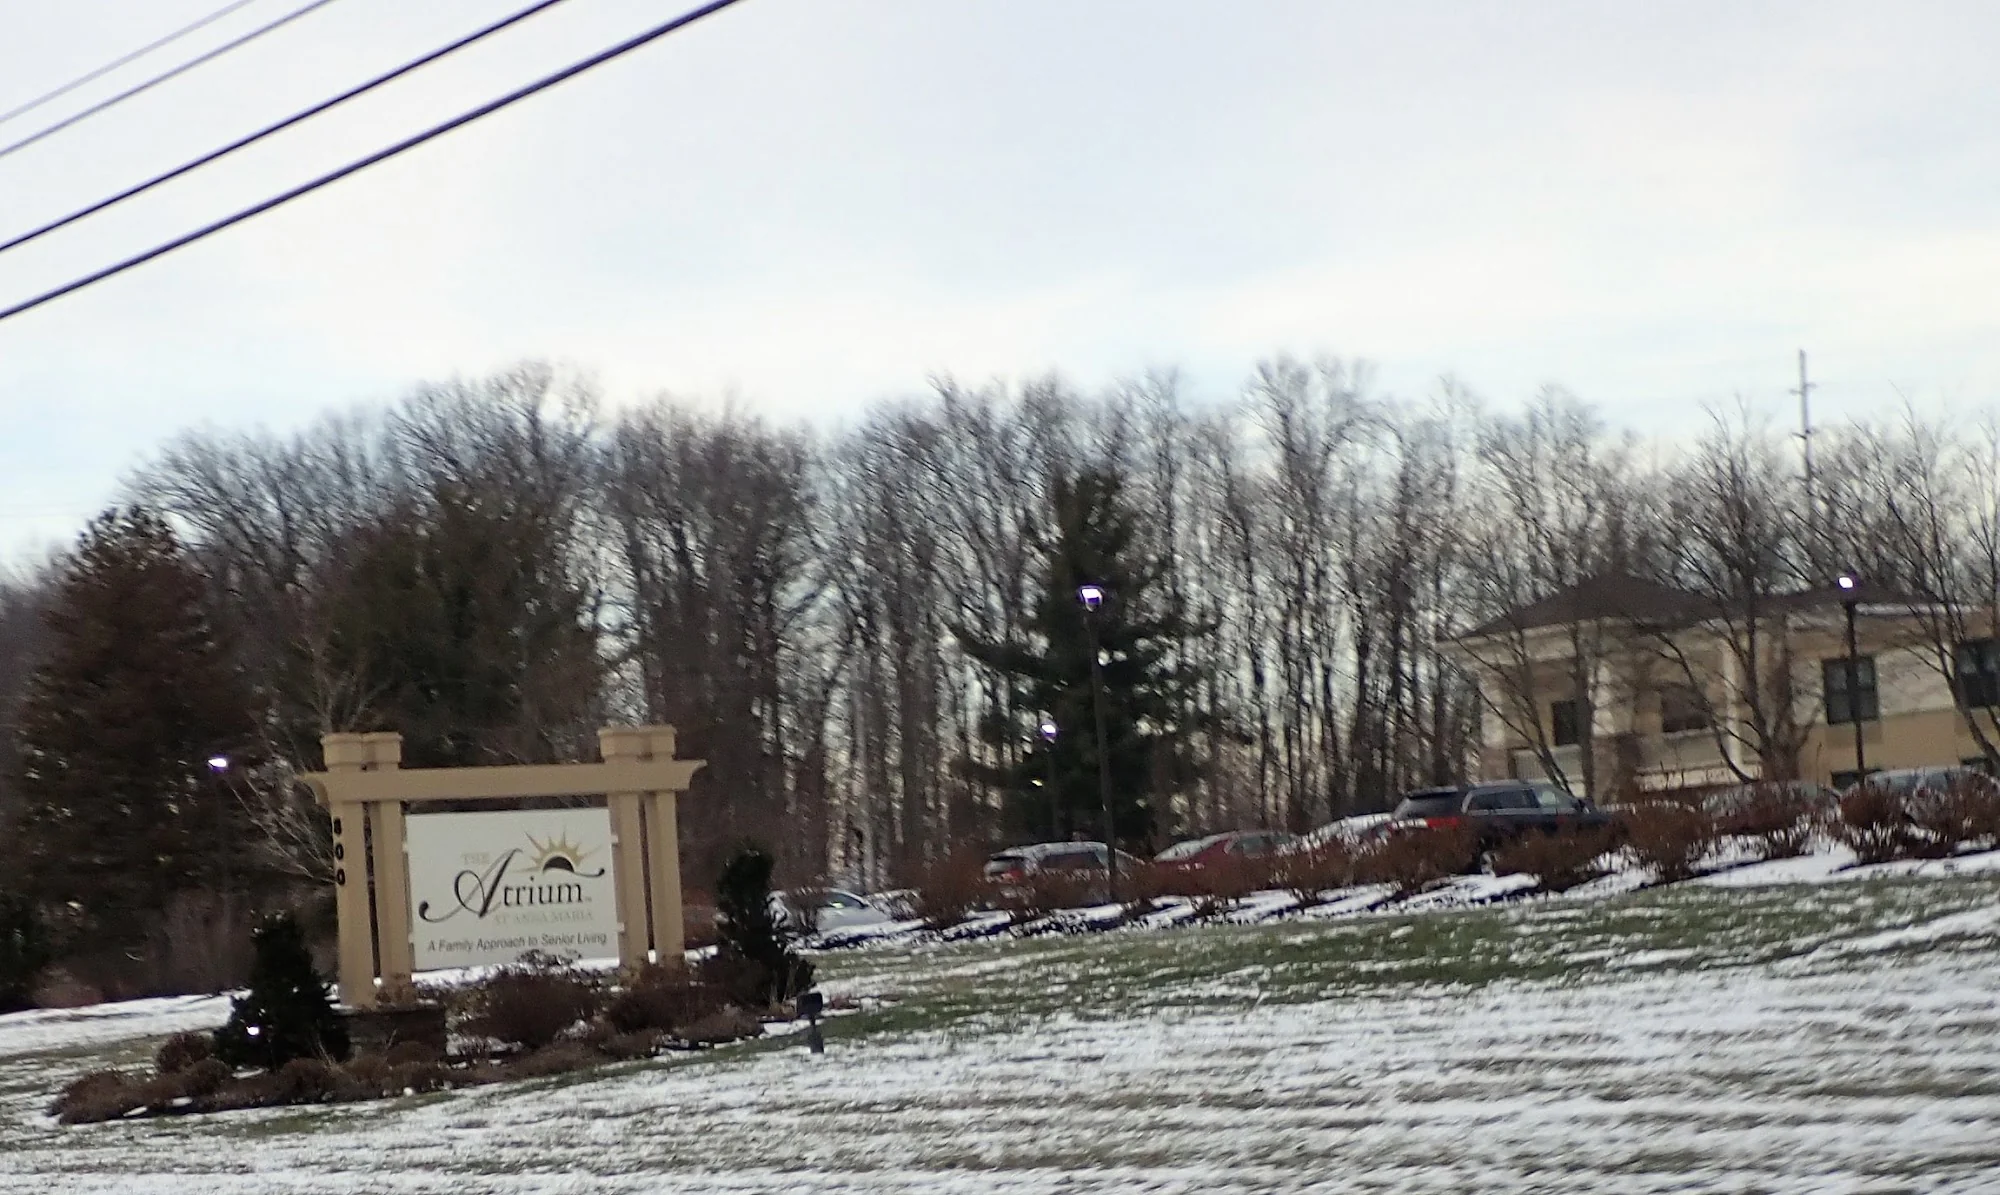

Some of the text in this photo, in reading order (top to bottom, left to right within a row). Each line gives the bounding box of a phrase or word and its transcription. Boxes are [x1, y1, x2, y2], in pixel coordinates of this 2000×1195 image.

[418, 848, 583, 922] Atrium
[428, 931, 607, 953] A Family Approach to Senior Living
